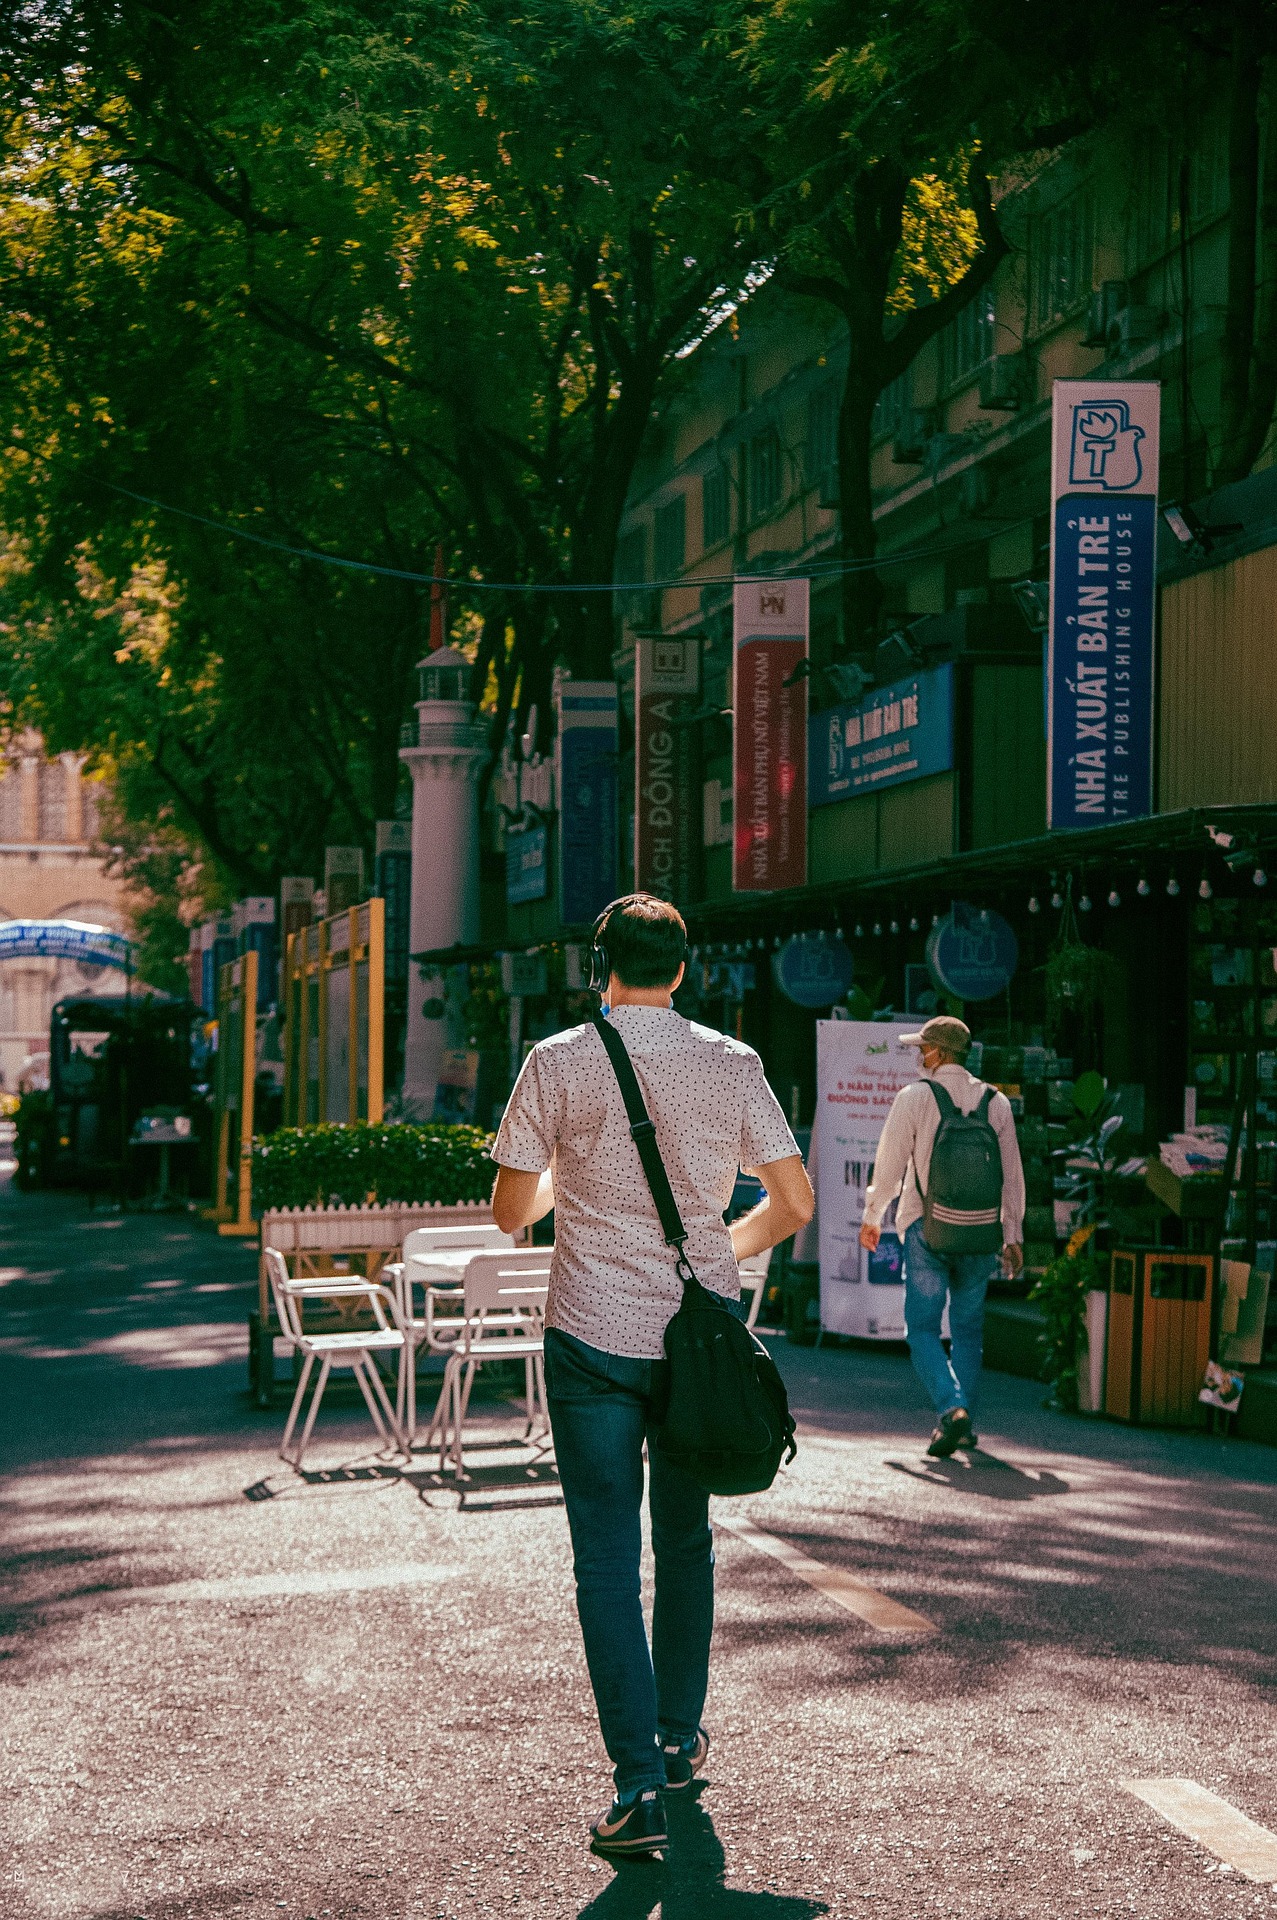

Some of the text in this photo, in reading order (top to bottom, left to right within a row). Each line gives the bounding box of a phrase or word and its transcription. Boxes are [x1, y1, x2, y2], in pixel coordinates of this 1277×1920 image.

[649, 700, 673, 720] A
[755, 652, 769, 686] NAM
[1065, 516, 1109, 813] NHÀ XUẤT BẢN TRẺ
[1113, 513, 1132, 816] TRE PUBLISHING HOUSE
[641, 731, 673, 828] ĐÔNG
